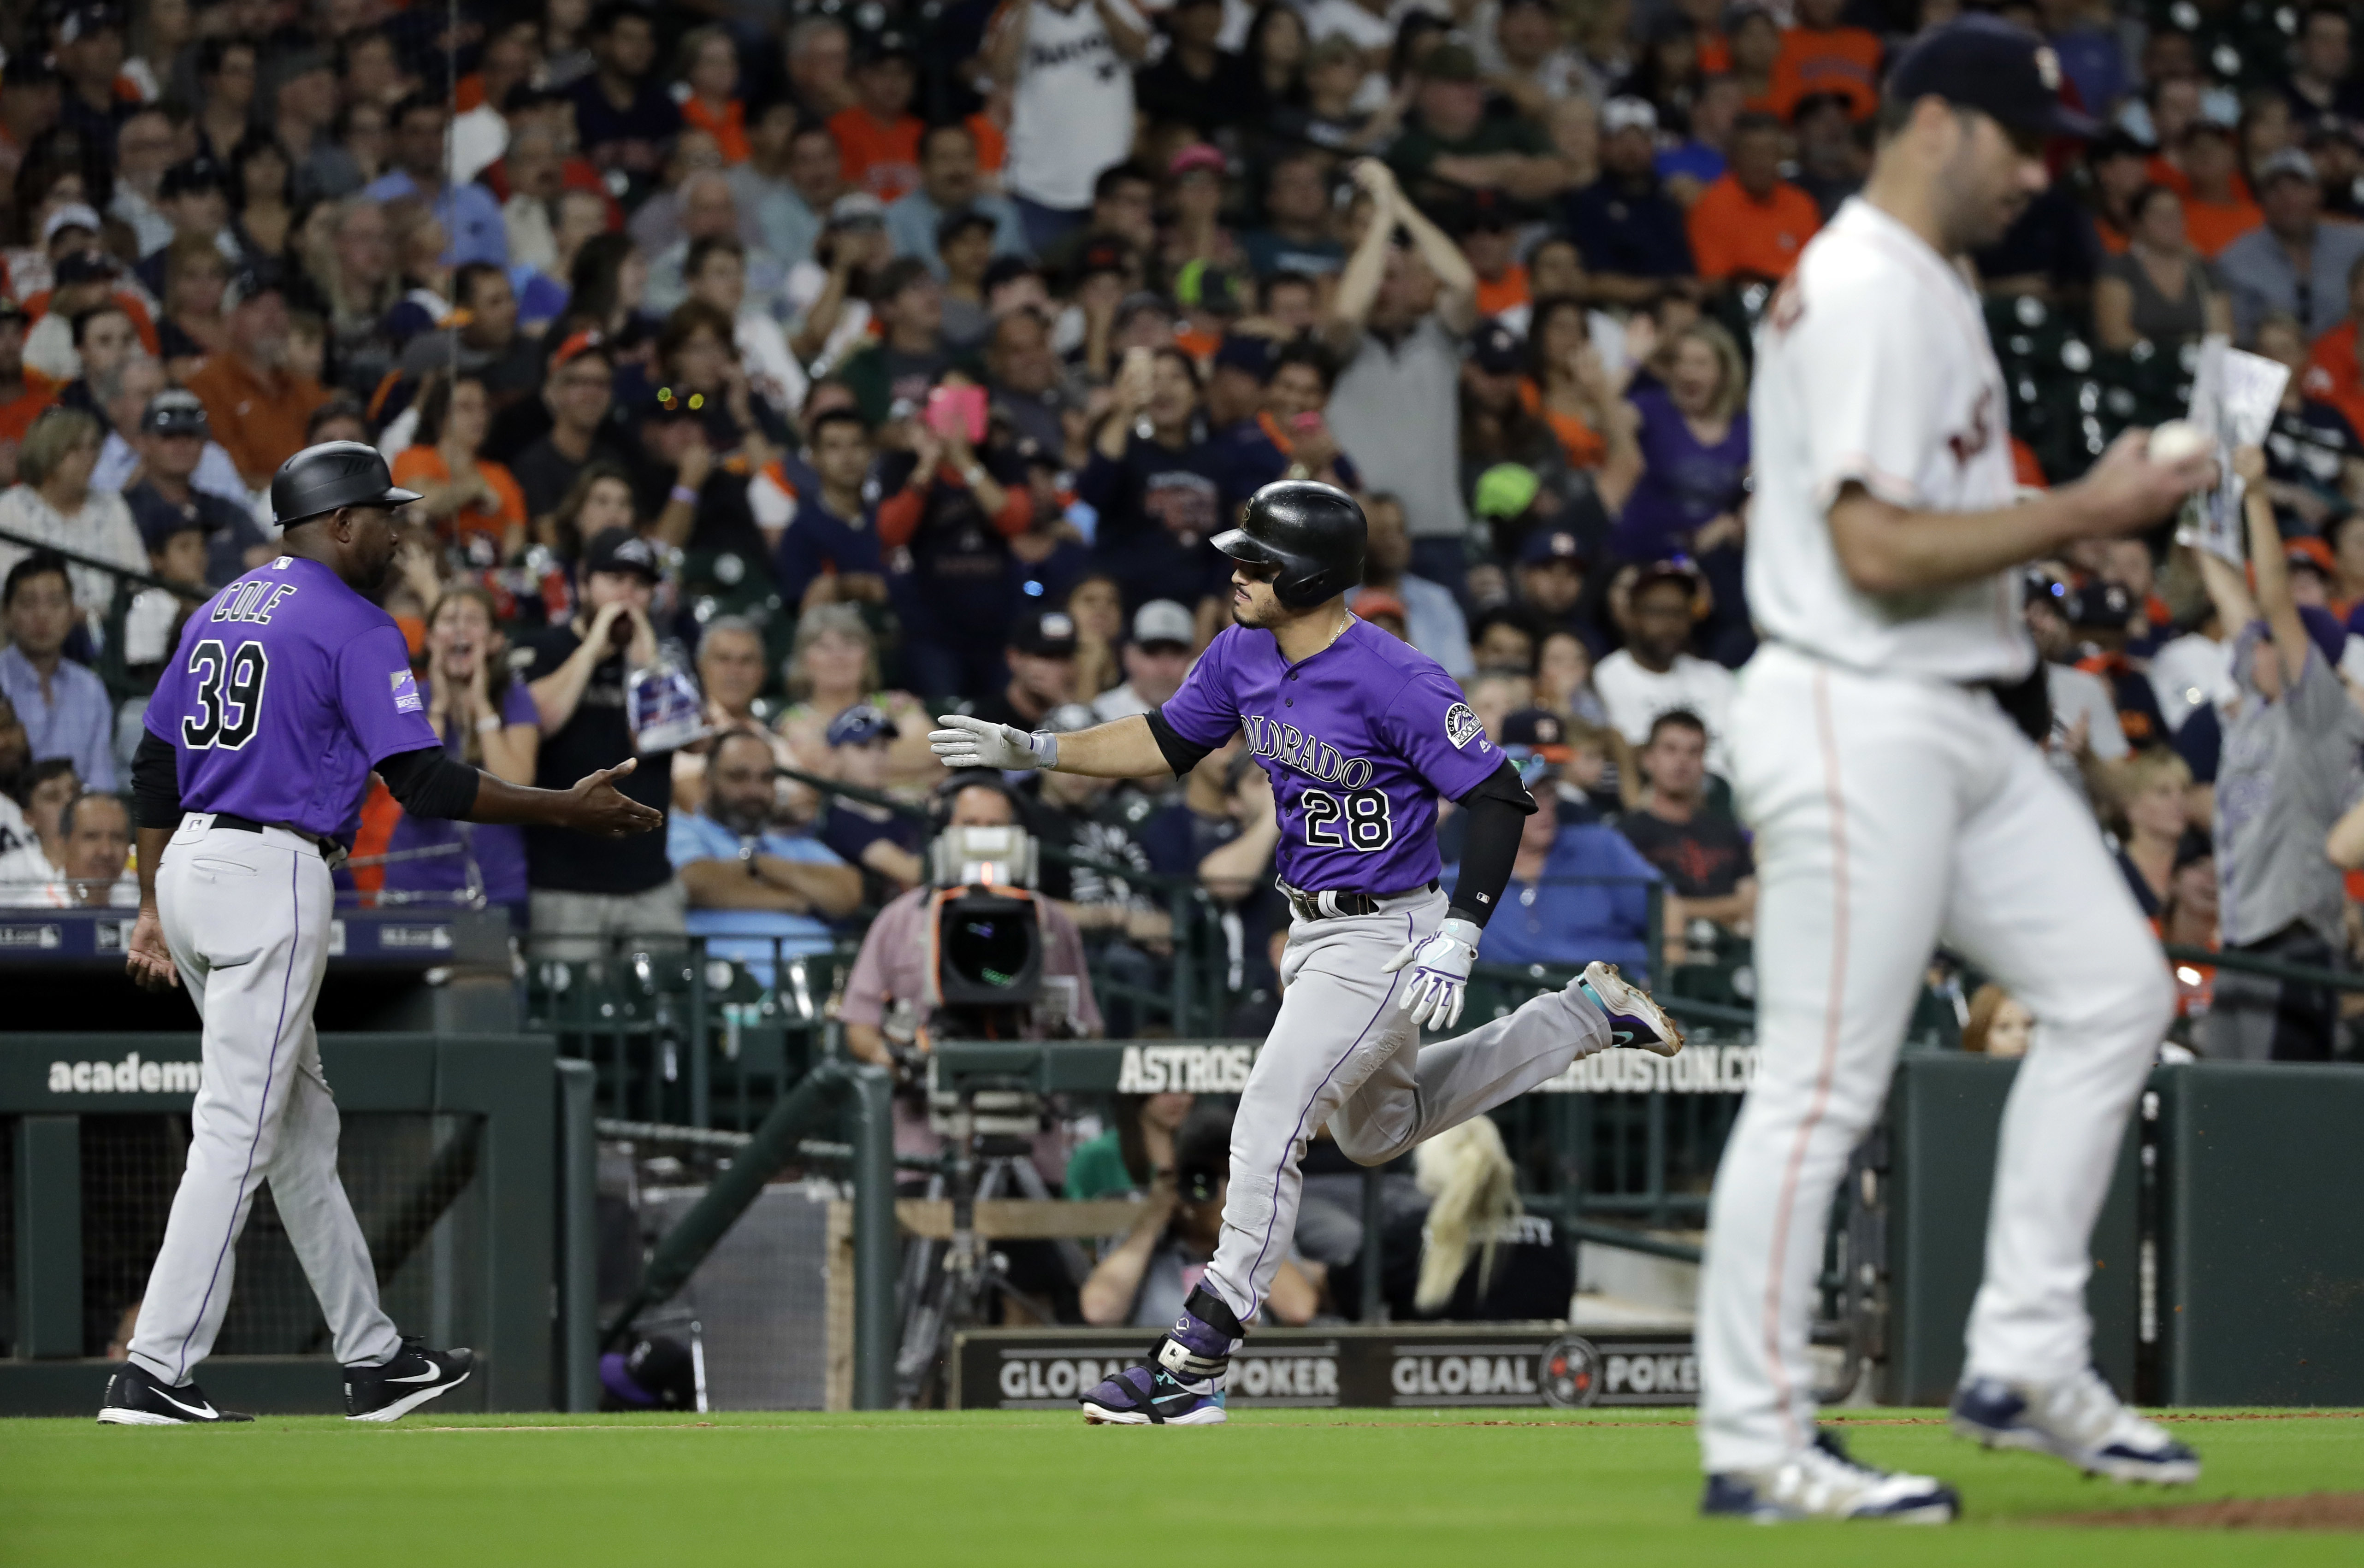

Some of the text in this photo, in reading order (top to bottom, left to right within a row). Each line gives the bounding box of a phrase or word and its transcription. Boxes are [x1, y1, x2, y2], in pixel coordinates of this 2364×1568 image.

[211, 580, 297, 625] COLE
[181, 639, 269, 751] 39
[1300, 787, 1392, 852] 28
[48, 1051, 203, 1093] academ
[1391, 1355, 1702, 1395] GLOBAL POKE
